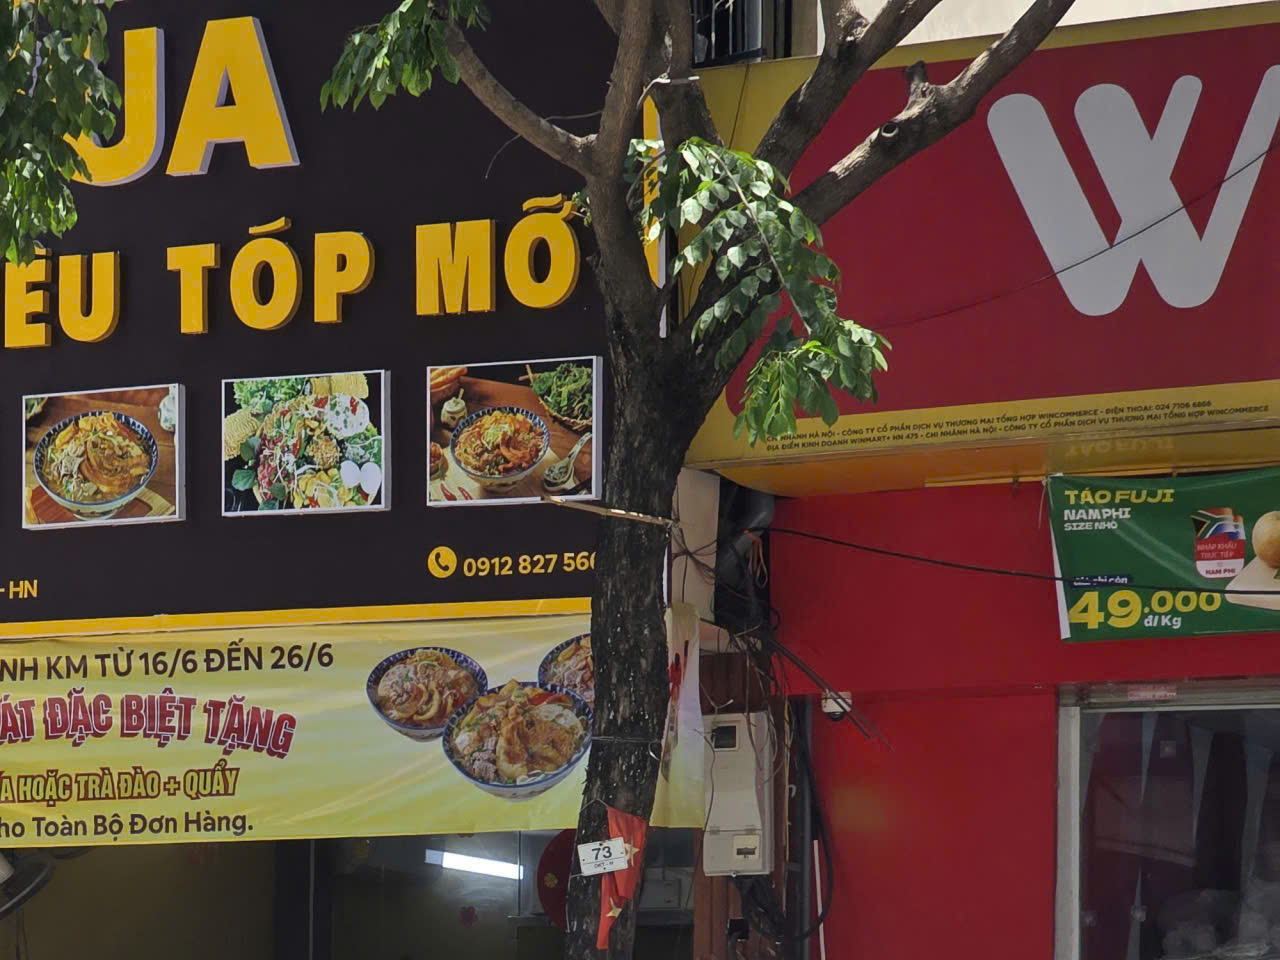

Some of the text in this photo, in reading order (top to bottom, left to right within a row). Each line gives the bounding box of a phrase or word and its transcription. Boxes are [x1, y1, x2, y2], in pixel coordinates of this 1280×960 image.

[166, 216, 376, 334] TÓP
[415, 193, 582, 317] MỠ
[821, 438, 848, 447] DOANH
[1207, 404, 1269, 416] WINCOMMERCE
[1039, 408, 1099, 420] WINCOMMERCE
[1064, 487, 1176, 505] TÁO FUJI
[1063, 521, 1093, 531] SIZE
[463, 553, 558, 577] 0912 827
[9, 579, 39, 600] HN
[1068, 589, 1222, 630] 49.000
[46, 654, 88, 680] KM
[95, 646, 135, 678] TỪ
[139, 648, 199, 679] 16/6
[204, 637, 264, 673] ĐẾN
[270, 641, 335, 672] 26/6
[43, 687, 114, 748] ĐẶC
[120, 687, 198, 749] BIỆT
[203, 694, 297, 760] TẶNG
[16, 768, 73, 808] HOẶC
[75, 766, 117, 802] TRÀ
[116, 765, 161, 801] ĐÀO
[183, 758, 241, 801] QUẨY
[31, 814, 88, 838] Toàn
[92, 813, 124, 841] Bộ
[128, 812, 178, 835] Đơn
[184, 810, 254, 837] Hàng.
[591, 846, 612, 861] 73
